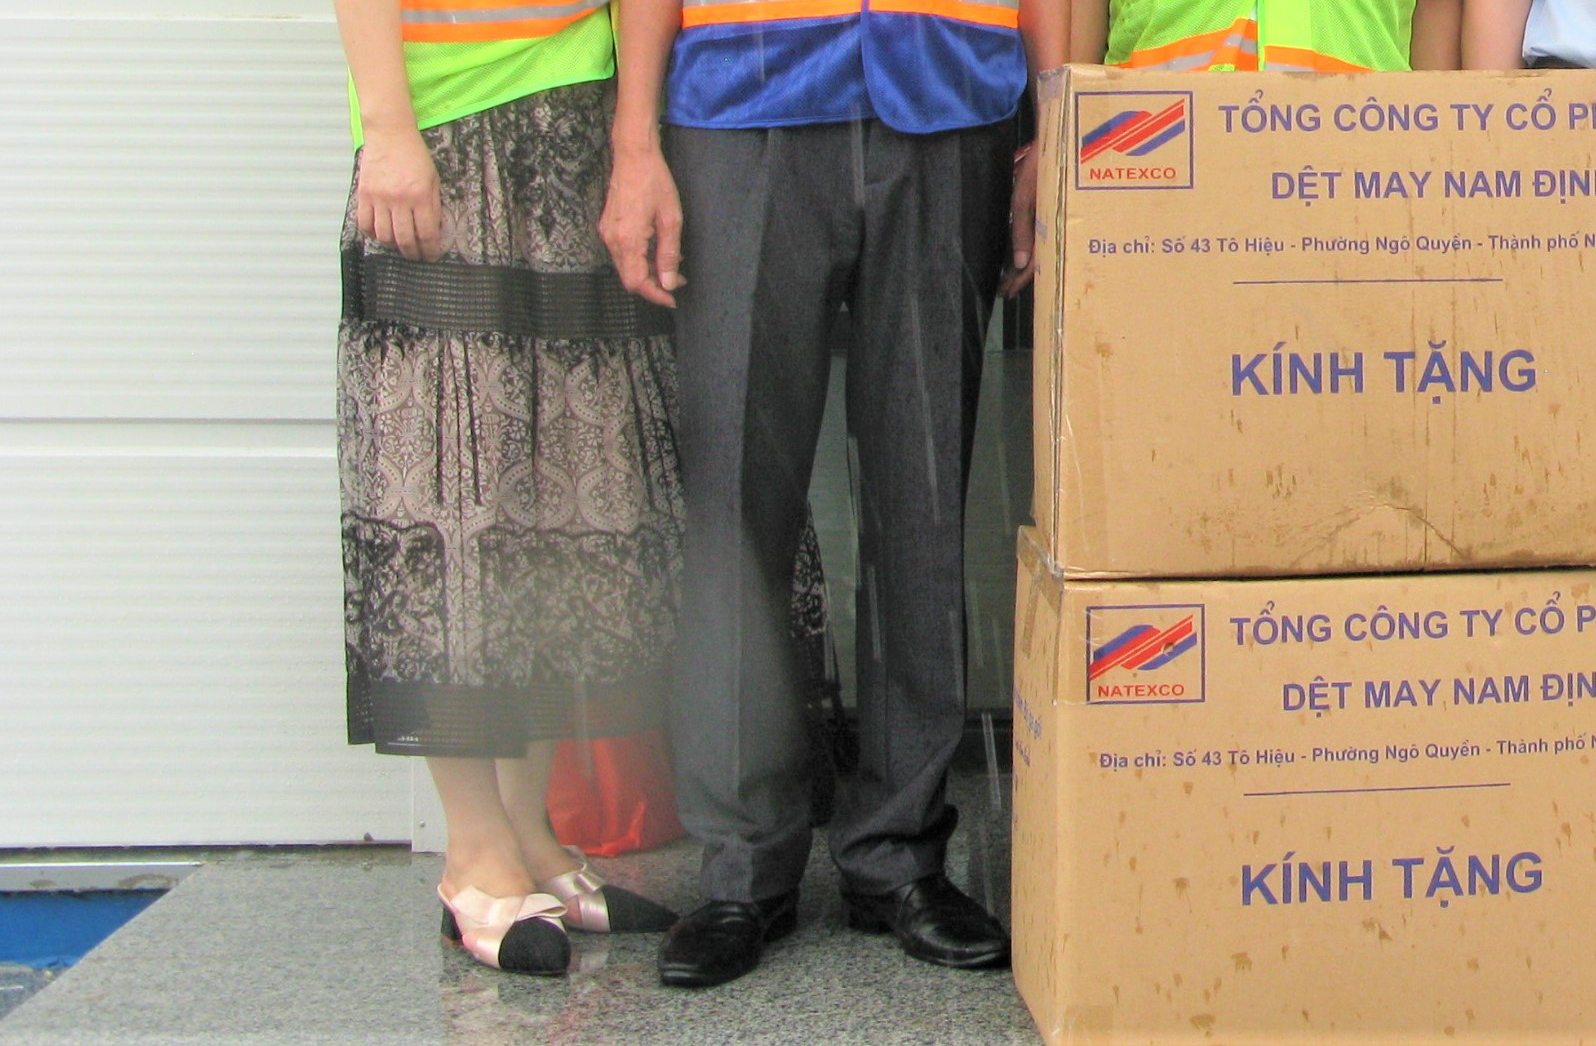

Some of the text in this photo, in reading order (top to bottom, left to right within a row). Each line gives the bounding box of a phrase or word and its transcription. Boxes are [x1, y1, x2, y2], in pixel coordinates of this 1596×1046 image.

[1218, 89, 1320, 133] TỔNG
[1334, 97, 1438, 131] CÔNG
[1452, 104, 1494, 131] TY
[1506, 88, 1556, 130] CỔ
[1089, 167, 1176, 180] NATEXCO
[1272, 165, 1342, 207] DỆT
[1355, 170, 1431, 198] MAY
[1445, 171, 1520, 198] NAM
[1089, 239, 1116, 257] Địa
[1162, 236, 1185, 253] Số
[1191, 238, 1210, 253] 43
[1216, 238, 1238, 252] Tô
[1246, 237, 1283, 256] Hiệu
[1302, 237, 1369, 254] Phường
[1376, 236, 1410, 254] Ngô
[1488, 234, 1540, 251] Thành
[1547, 231, 1579, 252] phố
[1232, 340, 1535, 404] KÍNH TẶNG
[1230, 601, 1331, 648] TỔNG
[1345, 606, 1448, 641] CÔNG
[1460, 609, 1503, 637] TY
[1515, 591, 1564, 635] CỔ
[1097, 684, 1184, 697] NATEXCO
[1283, 676, 1352, 718] DỆT
[1365, 679, 1441, 708] MAY
[1454, 675, 1529, 705] NAM
[1100, 753, 1127, 771] Địa
[1173, 749, 1196, 766] Số
[1202, 751, 1221, 765] 43
[1228, 750, 1249, 767] Tô
[1257, 749, 1294, 767] Hiệu
[1313, 748, 1378, 763] Phường
[1386, 744, 1419, 762] Ngô
[1496, 738, 1548, 754] Thành
[1555, 735, 1585, 755] phố
[1242, 846, 1542, 908] KÍNH TẶNG
